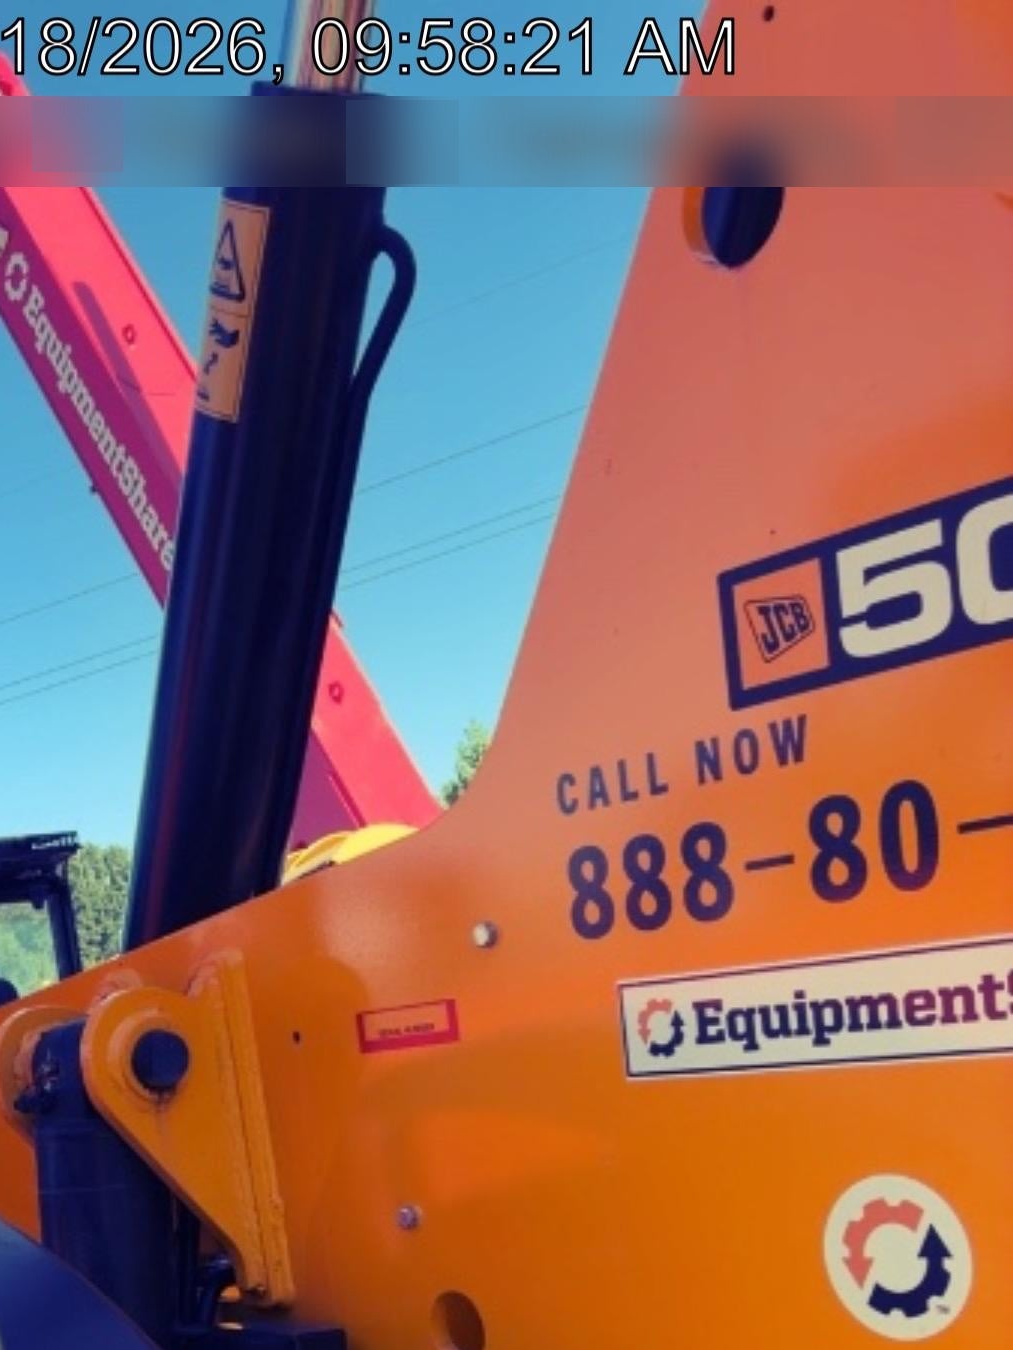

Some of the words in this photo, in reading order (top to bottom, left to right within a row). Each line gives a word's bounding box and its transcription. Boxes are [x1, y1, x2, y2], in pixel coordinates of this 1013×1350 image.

[756, 602, 811, 654] JCB
[556, 753, 669, 815] CALL
[695, 714, 807, 784] NOW
[692, 972, 1013, 1053] Equipment
